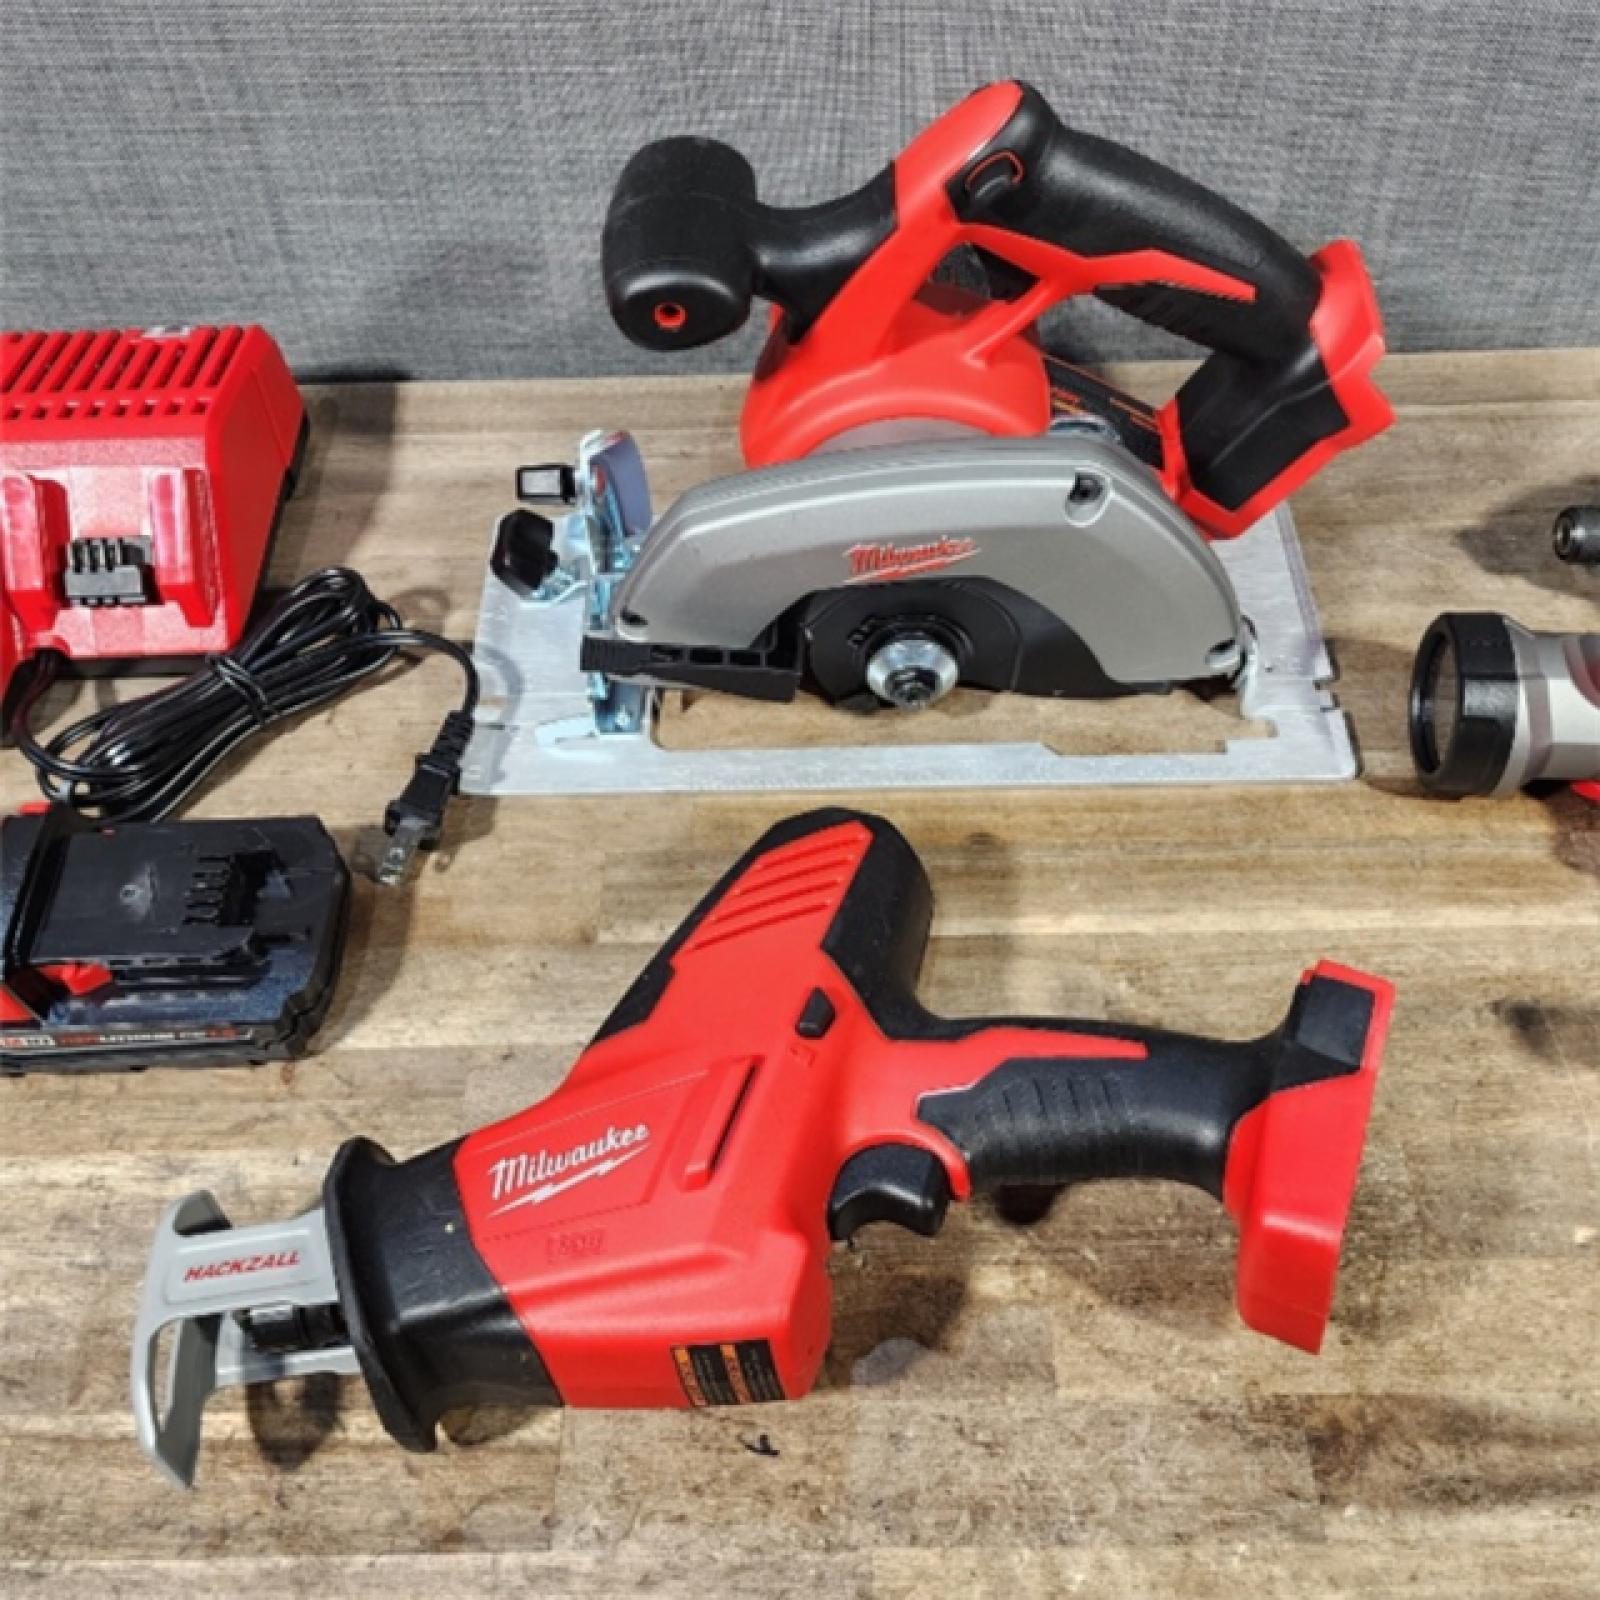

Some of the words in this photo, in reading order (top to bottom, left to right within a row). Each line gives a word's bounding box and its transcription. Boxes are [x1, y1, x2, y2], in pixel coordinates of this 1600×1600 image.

[843, 535, 975, 575] Milwaukee
[488, 1121, 650, 1201] Milwaukee
[184, 1250, 300, 1282] HACKZALL
